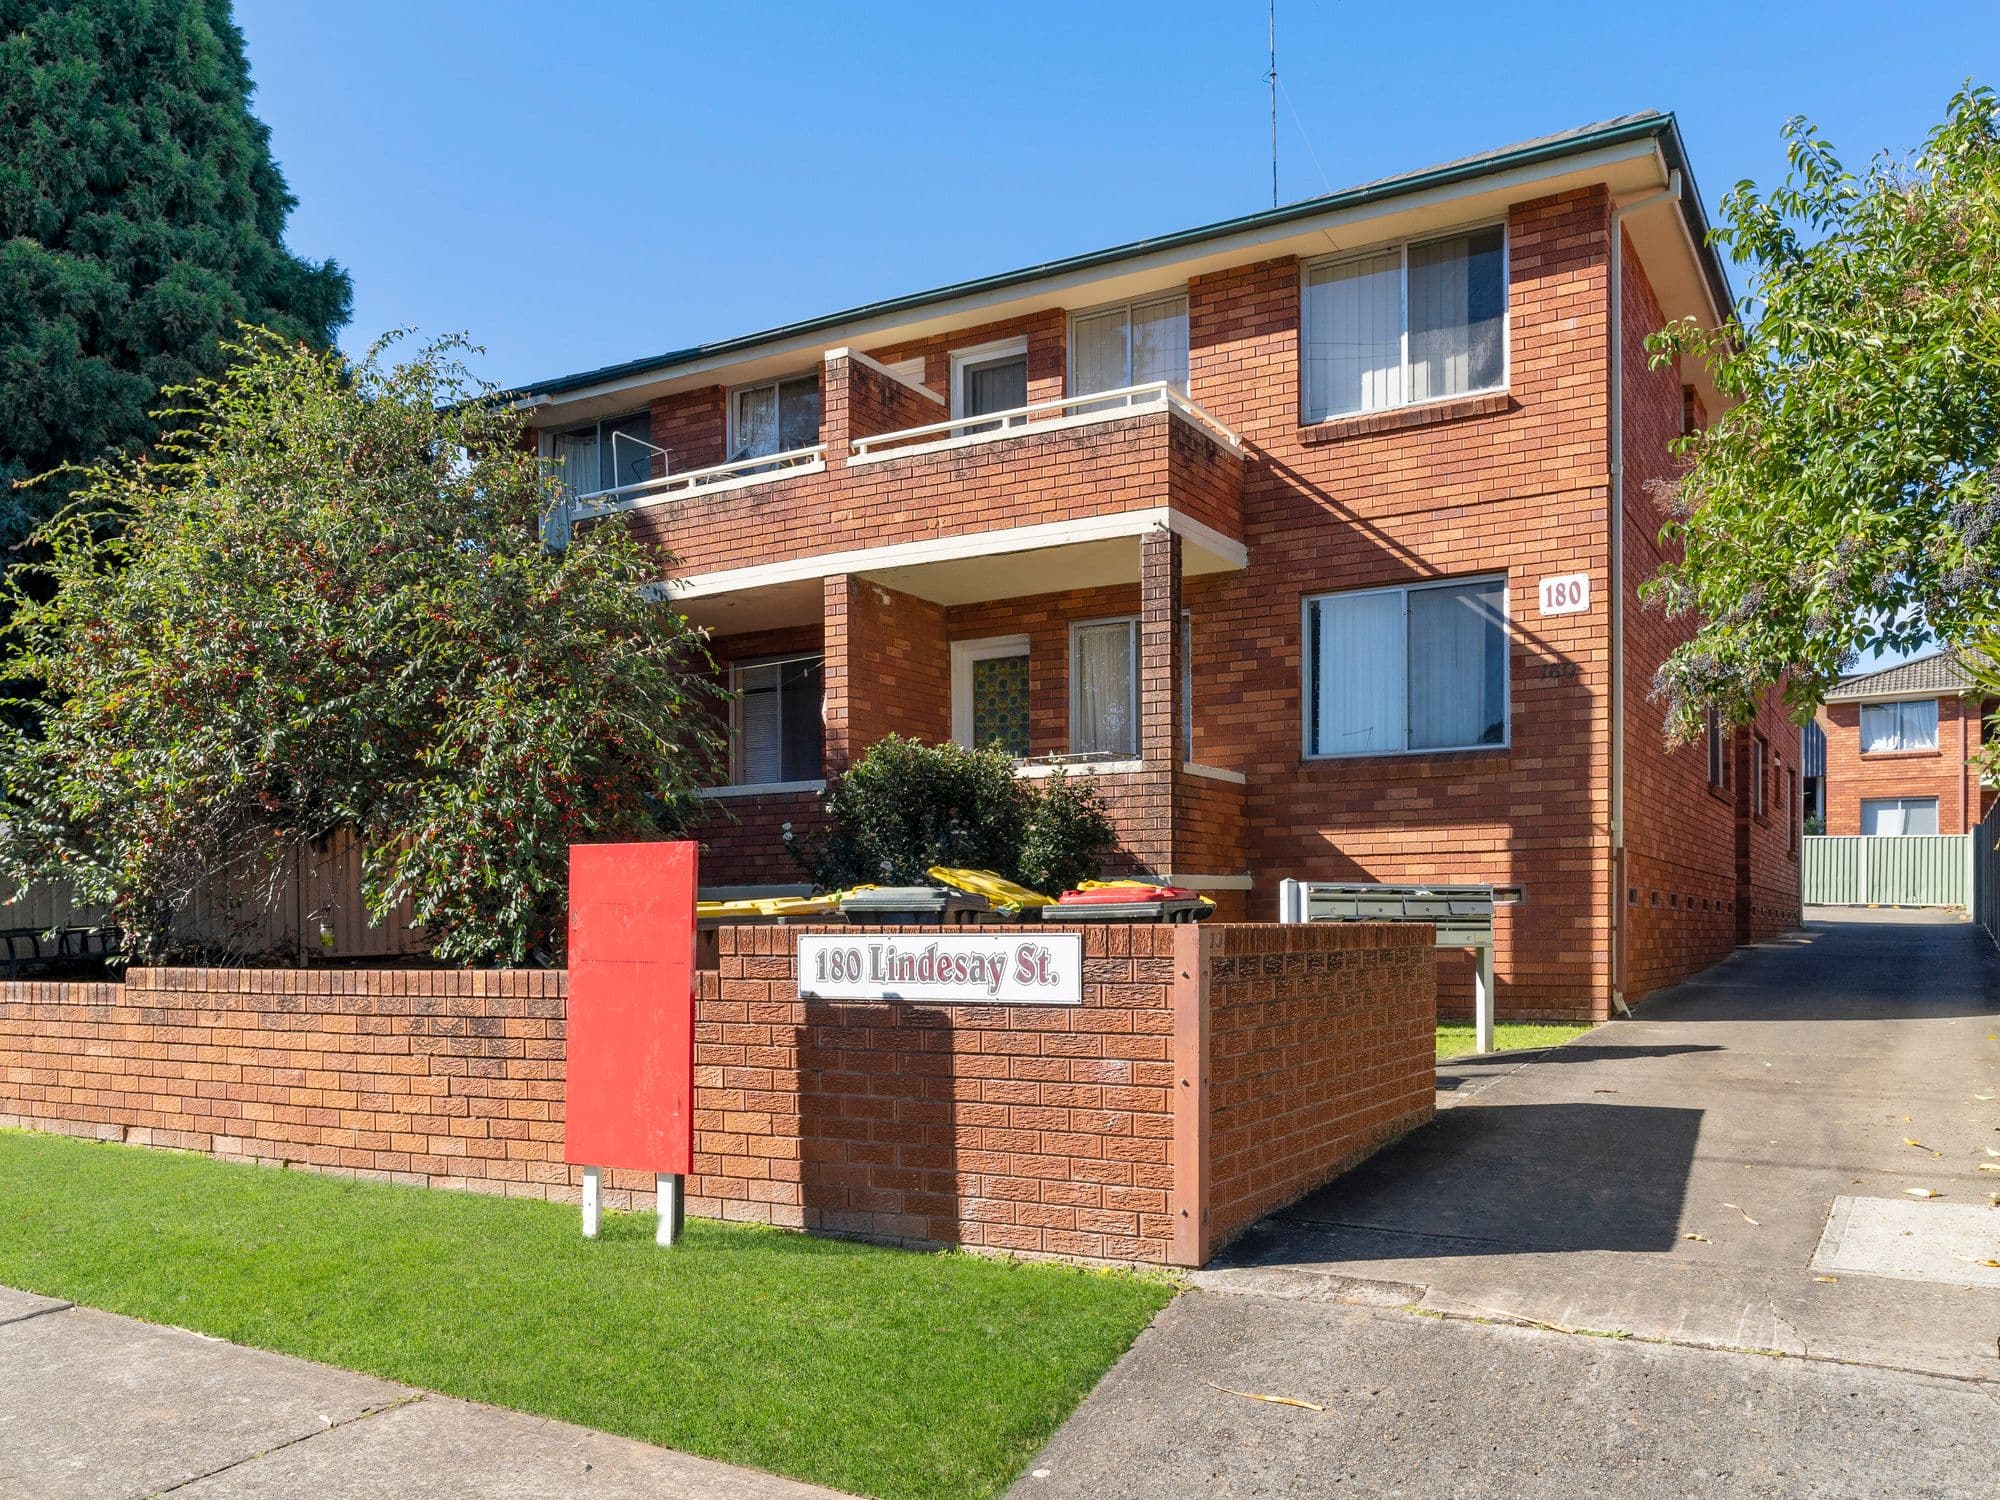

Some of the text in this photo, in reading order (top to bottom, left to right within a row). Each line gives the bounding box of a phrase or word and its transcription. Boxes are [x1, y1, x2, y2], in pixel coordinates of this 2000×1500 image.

[1546, 581, 1581, 607] 180
[815, 942, 1060, 995] 180 Lindesay St.
